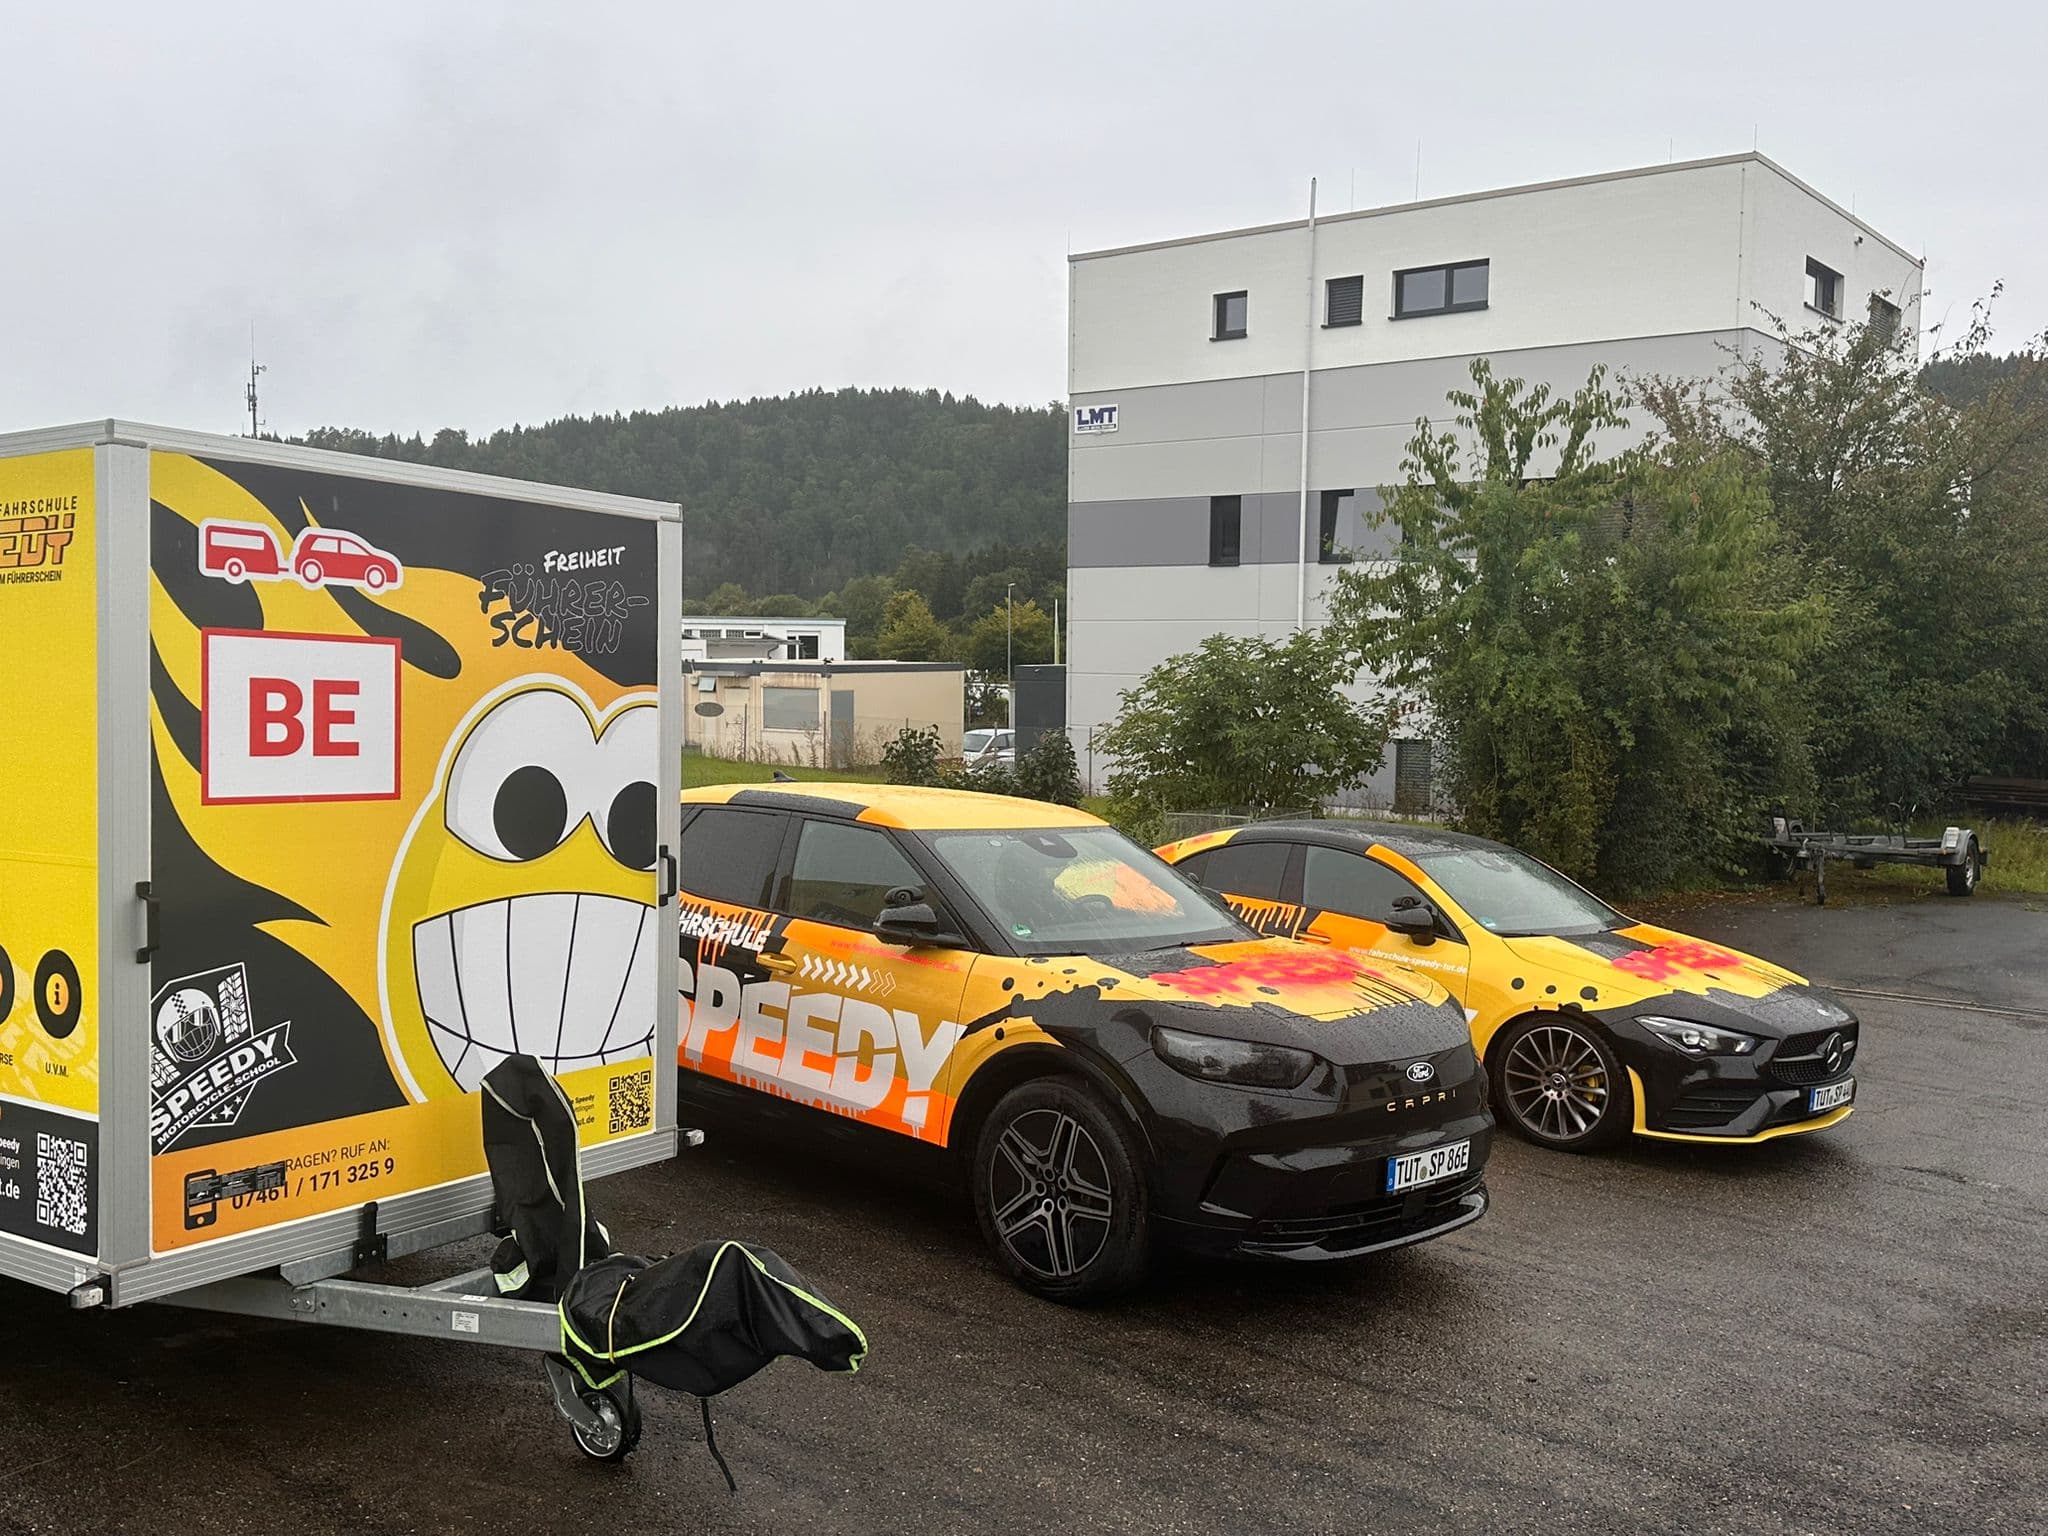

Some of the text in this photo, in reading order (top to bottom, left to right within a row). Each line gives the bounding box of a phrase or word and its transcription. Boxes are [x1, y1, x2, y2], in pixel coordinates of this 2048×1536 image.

[1077, 407, 1116, 425] LMT
[7, 570, 62, 584] FÜHRERSCHEIN
[543, 546, 626, 573] FREIHEIT
[478, 563, 650, 619] FÜHRER-
[490, 610, 623, 654] SCHEIN
[249, 677, 360, 757] BE
[679, 909, 772, 953] HRSCHULE
[151, 1032, 277, 1136] SPEEDY
[156, 1057, 281, 1145] MOTORCYCLE-SCHOOL
[1386, 1089, 1456, 1112] CAPRI
[1816, 1088, 1831, 1107] TUT
[285, 1138, 390, 1171] RAGEN? RUF AN:
[1397, 1144, 1469, 1185] TUT SP 86E
[309, 1170, 341, 1192] 171
[346, 1160, 379, 1183] 325
[384, 1157, 395, 1175] 9
